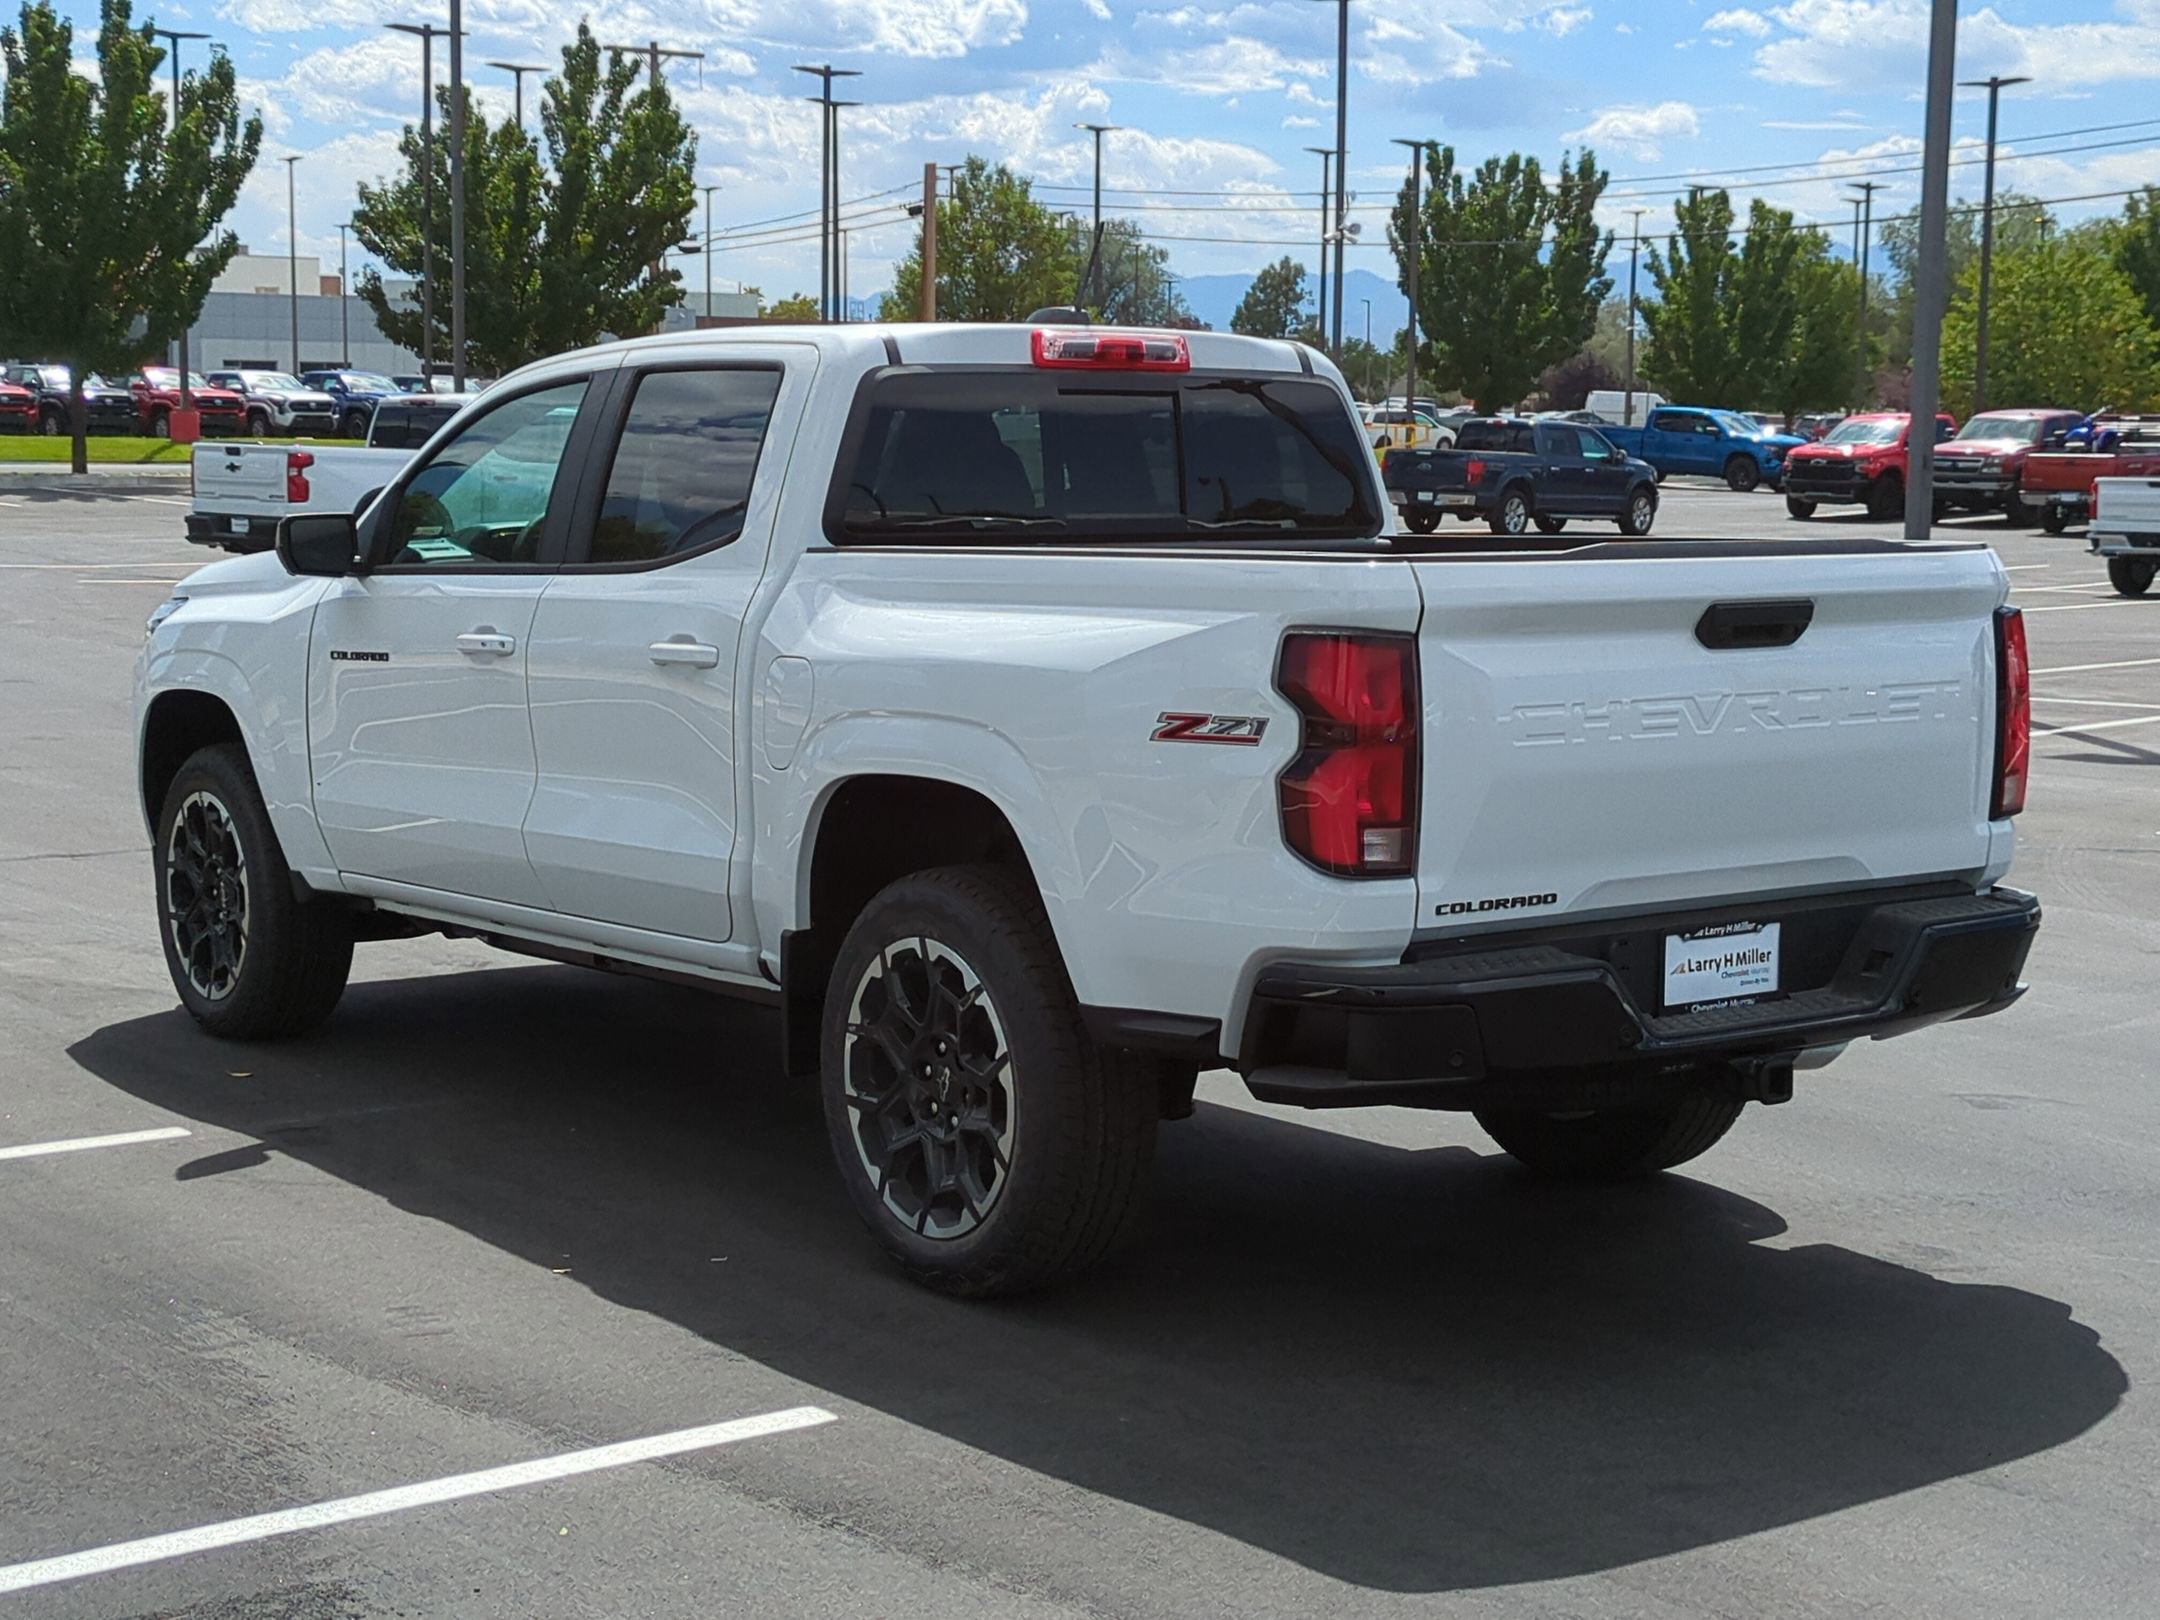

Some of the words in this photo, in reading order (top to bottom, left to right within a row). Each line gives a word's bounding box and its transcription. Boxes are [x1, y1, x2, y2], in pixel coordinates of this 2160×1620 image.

[1512, 678, 1962, 746] CHEVROLET
[1149, 711, 1270, 747] Z71
[1435, 892, 1558, 916] COLORADO
[1687, 958, 1722, 973] Larry
[1724, 953, 1733, 968] H
[1735, 948, 1771, 967] Miller
